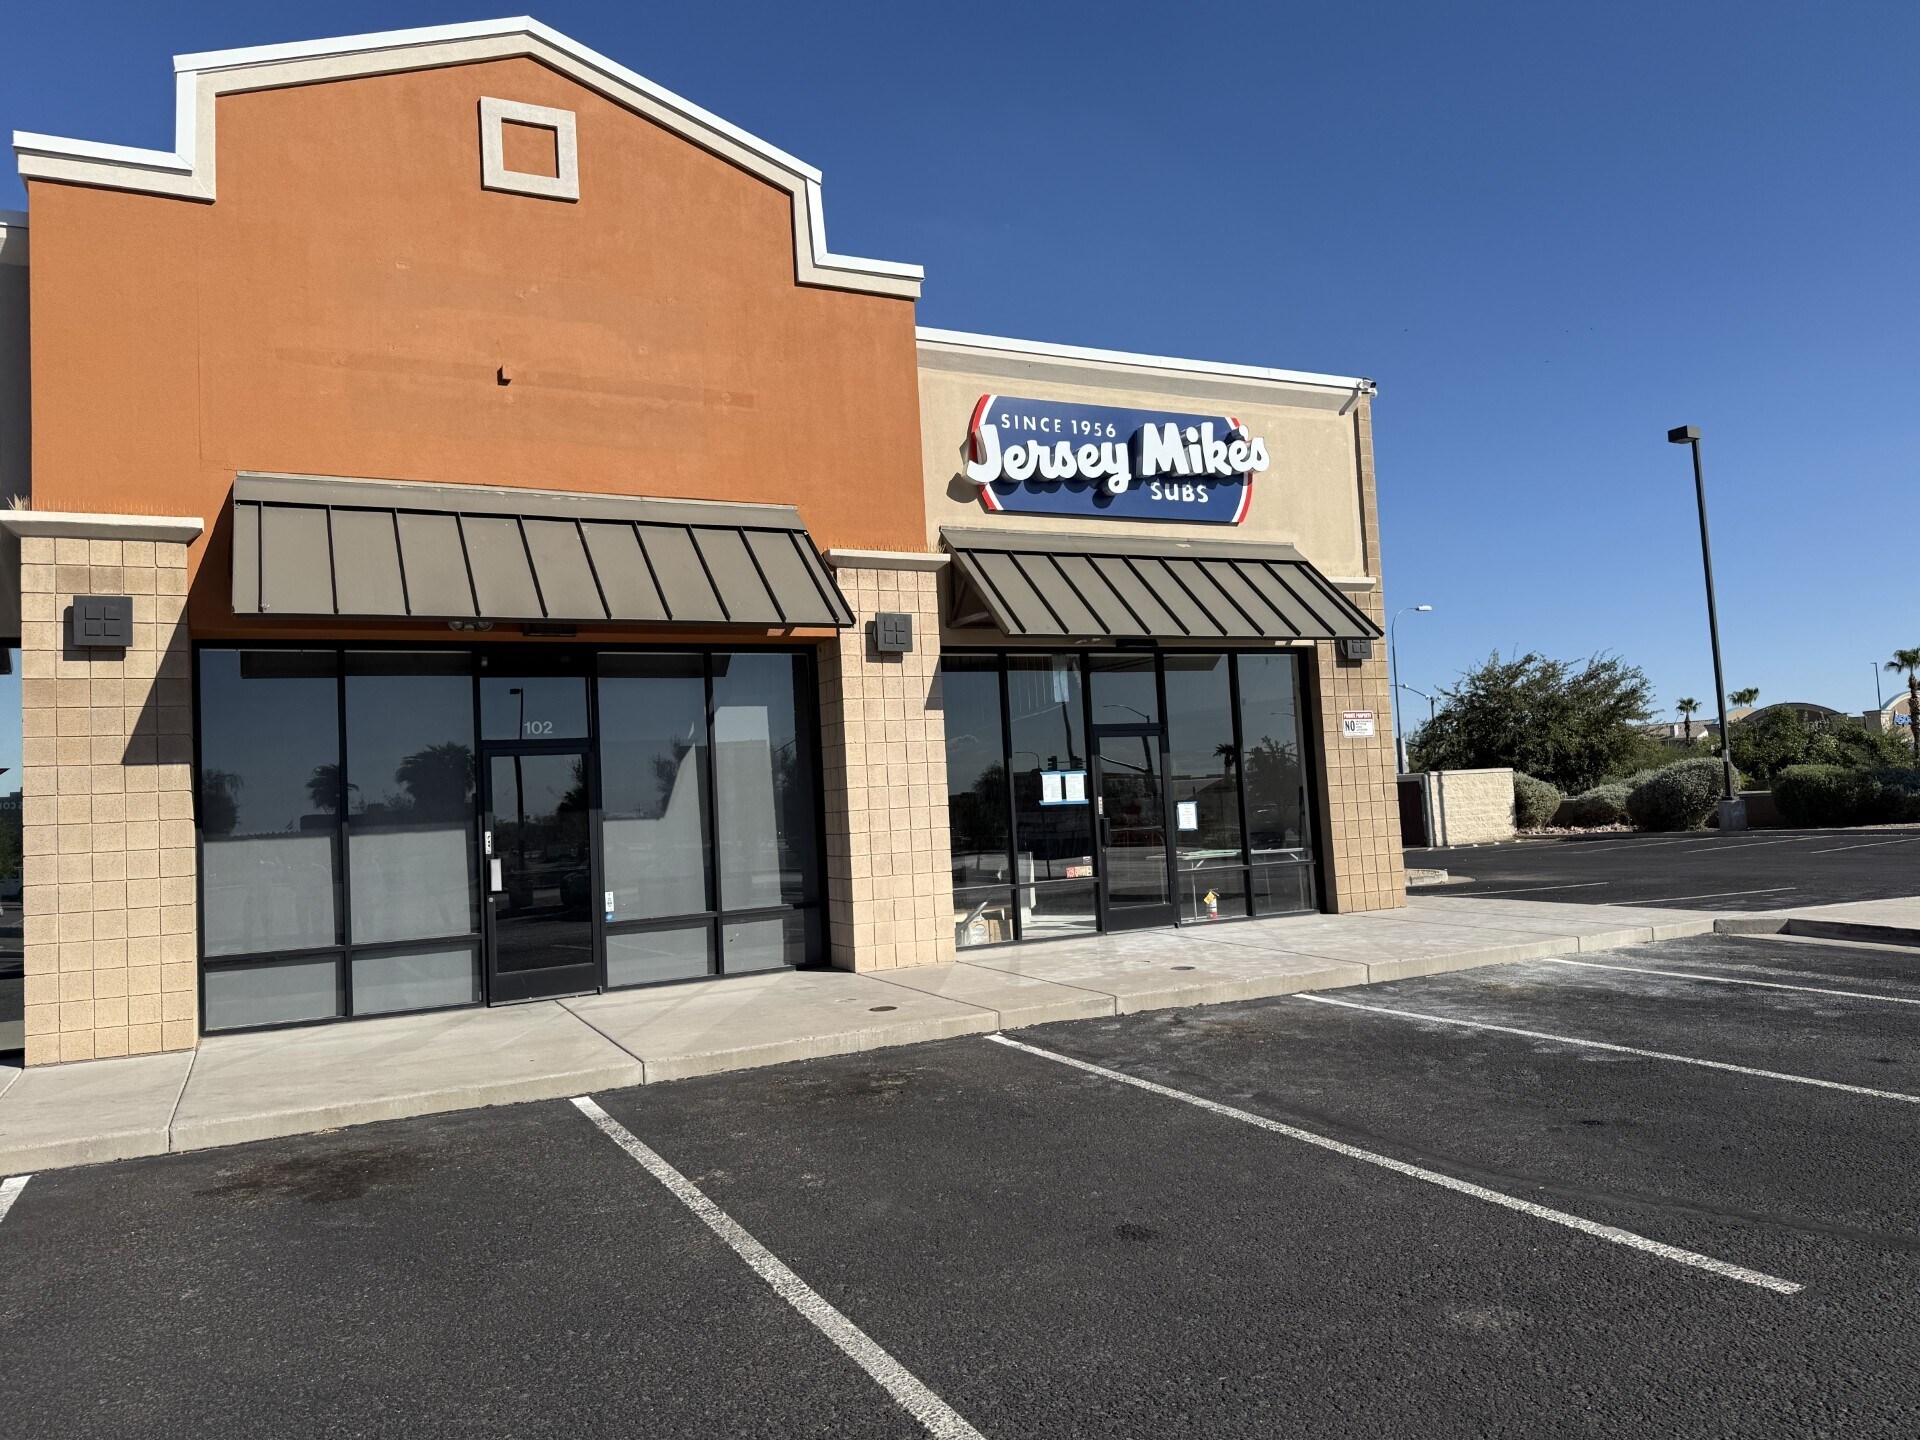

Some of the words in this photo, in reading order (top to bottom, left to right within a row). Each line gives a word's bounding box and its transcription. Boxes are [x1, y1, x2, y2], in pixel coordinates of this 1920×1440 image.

[1001, 413, 1062, 433] SINCE
[1071, 420, 1116, 437] 1956
[966, 424, 1131, 494] Jersey
[1142, 421, 1270, 476] Mike's
[1150, 481, 1208, 503] SUBS
[524, 720, 553, 734] 102
[1344, 720, 1355, 731] NO
